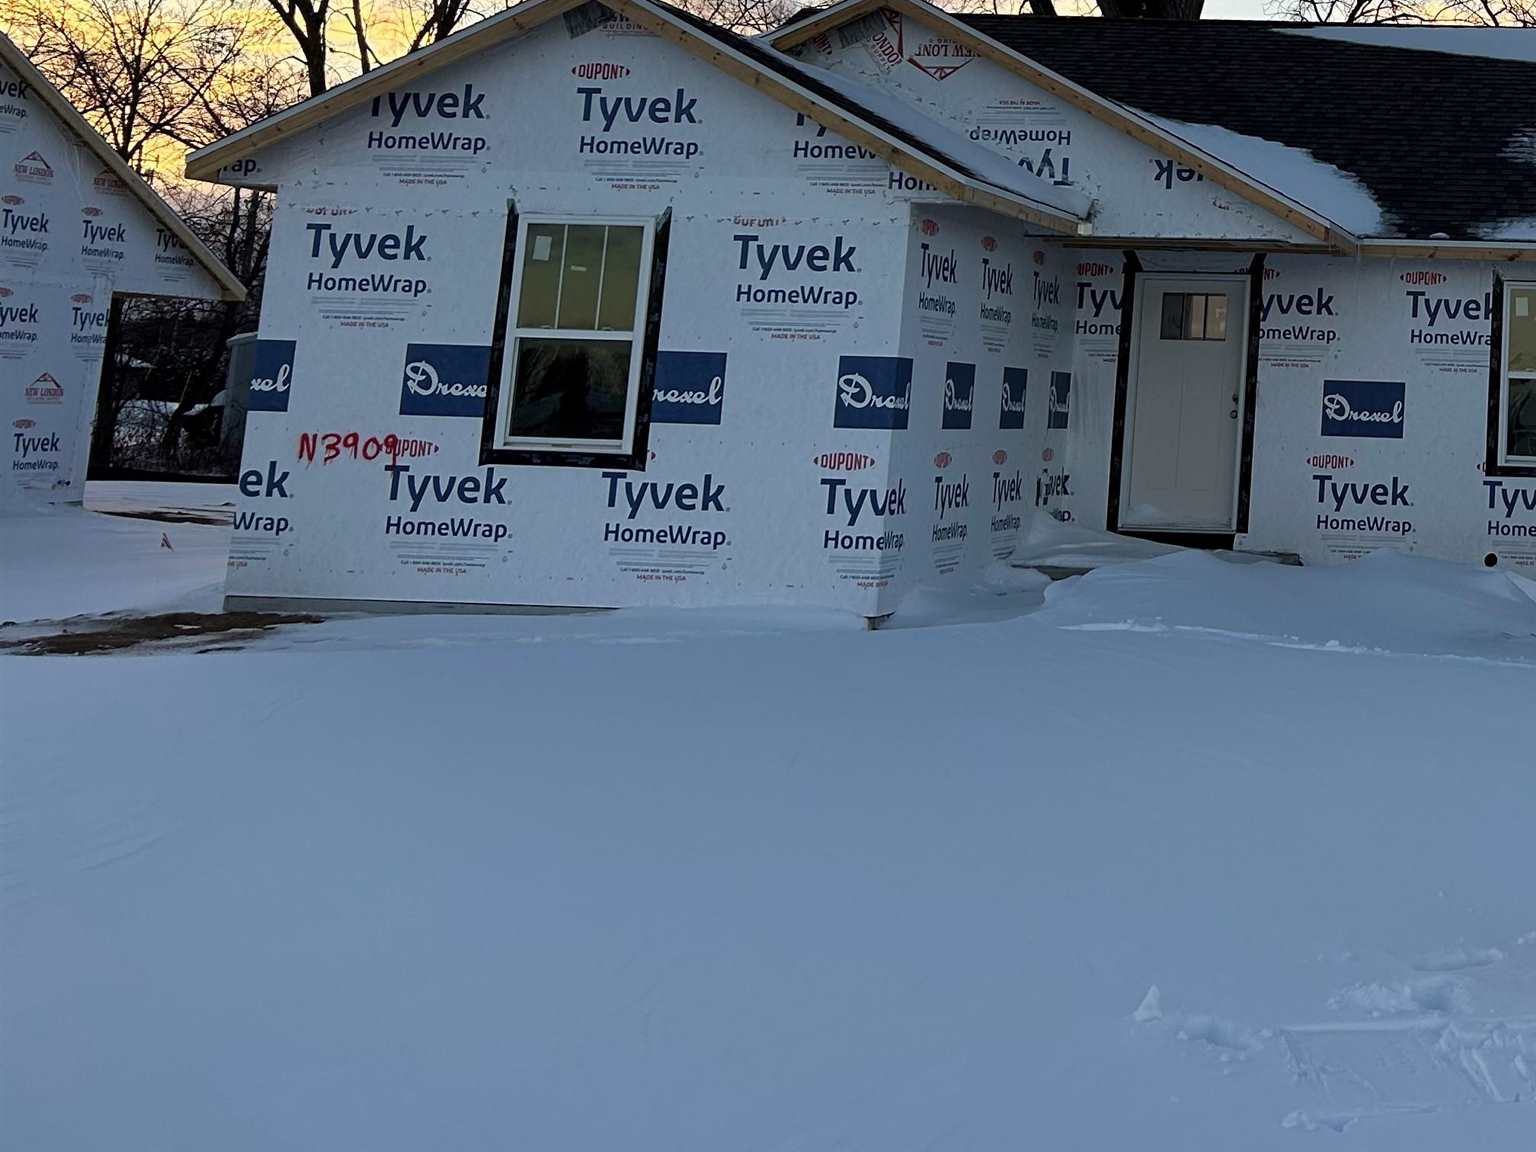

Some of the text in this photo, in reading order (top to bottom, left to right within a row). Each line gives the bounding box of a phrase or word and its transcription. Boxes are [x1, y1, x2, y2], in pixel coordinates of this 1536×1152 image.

[578, 63, 625, 80] DUPONT
[576, 87, 697, 132] Tyvek
[368, 132, 486, 154] HomeWrap
[579, 136, 699, 159] HomeWrap
[969, 126, 1071, 145] HomeWrap
[2, 209, 49, 234] Tyvek
[82, 220, 127, 244] Tyvek
[1, 236, 48, 252] HomeWrap
[81, 246, 125, 260] HomeWrap
[306, 223, 427, 269] Tyvek
[733, 234, 856, 280] Tyvek
[921, 242, 957, 288] Tyvek
[307, 272, 427, 297] HomeWrap
[982, 258, 1013, 299] Tyvek
[1033, 272, 1060, 309] Tyvek
[1405, 272, 1442, 285] DUPONT
[736, 284, 858, 309] HomeWrap
[919, 292, 955, 317] HomeWrap
[980, 303, 1011, 323] HomeWrap
[1324, 393, 1402, 423] Drexel
[13, 433, 60, 458] Tyvek
[297, 432, 398, 466] N3909
[13, 460, 58, 472] HomeWrap
[821, 452, 869, 471] DUPONT
[1312, 455, 1349, 469] DUPONT
[384, 465, 508, 512] Tyvek
[602, 472, 725, 519] Tyvek
[934, 473, 970, 520] Tyvek
[993, 470, 1022, 511] Tyvek
[1312, 475, 1409, 512] Tyvek
[820, 478, 906, 526] Tyvek
[385, 516, 508, 542] HomeWrap
[604, 523, 727, 550] HomeWrap
[932, 523, 967, 543] HomeWrap
[1317, 515, 1412, 535] HomeWrap
[824, 530, 904, 551] HomeWrap
